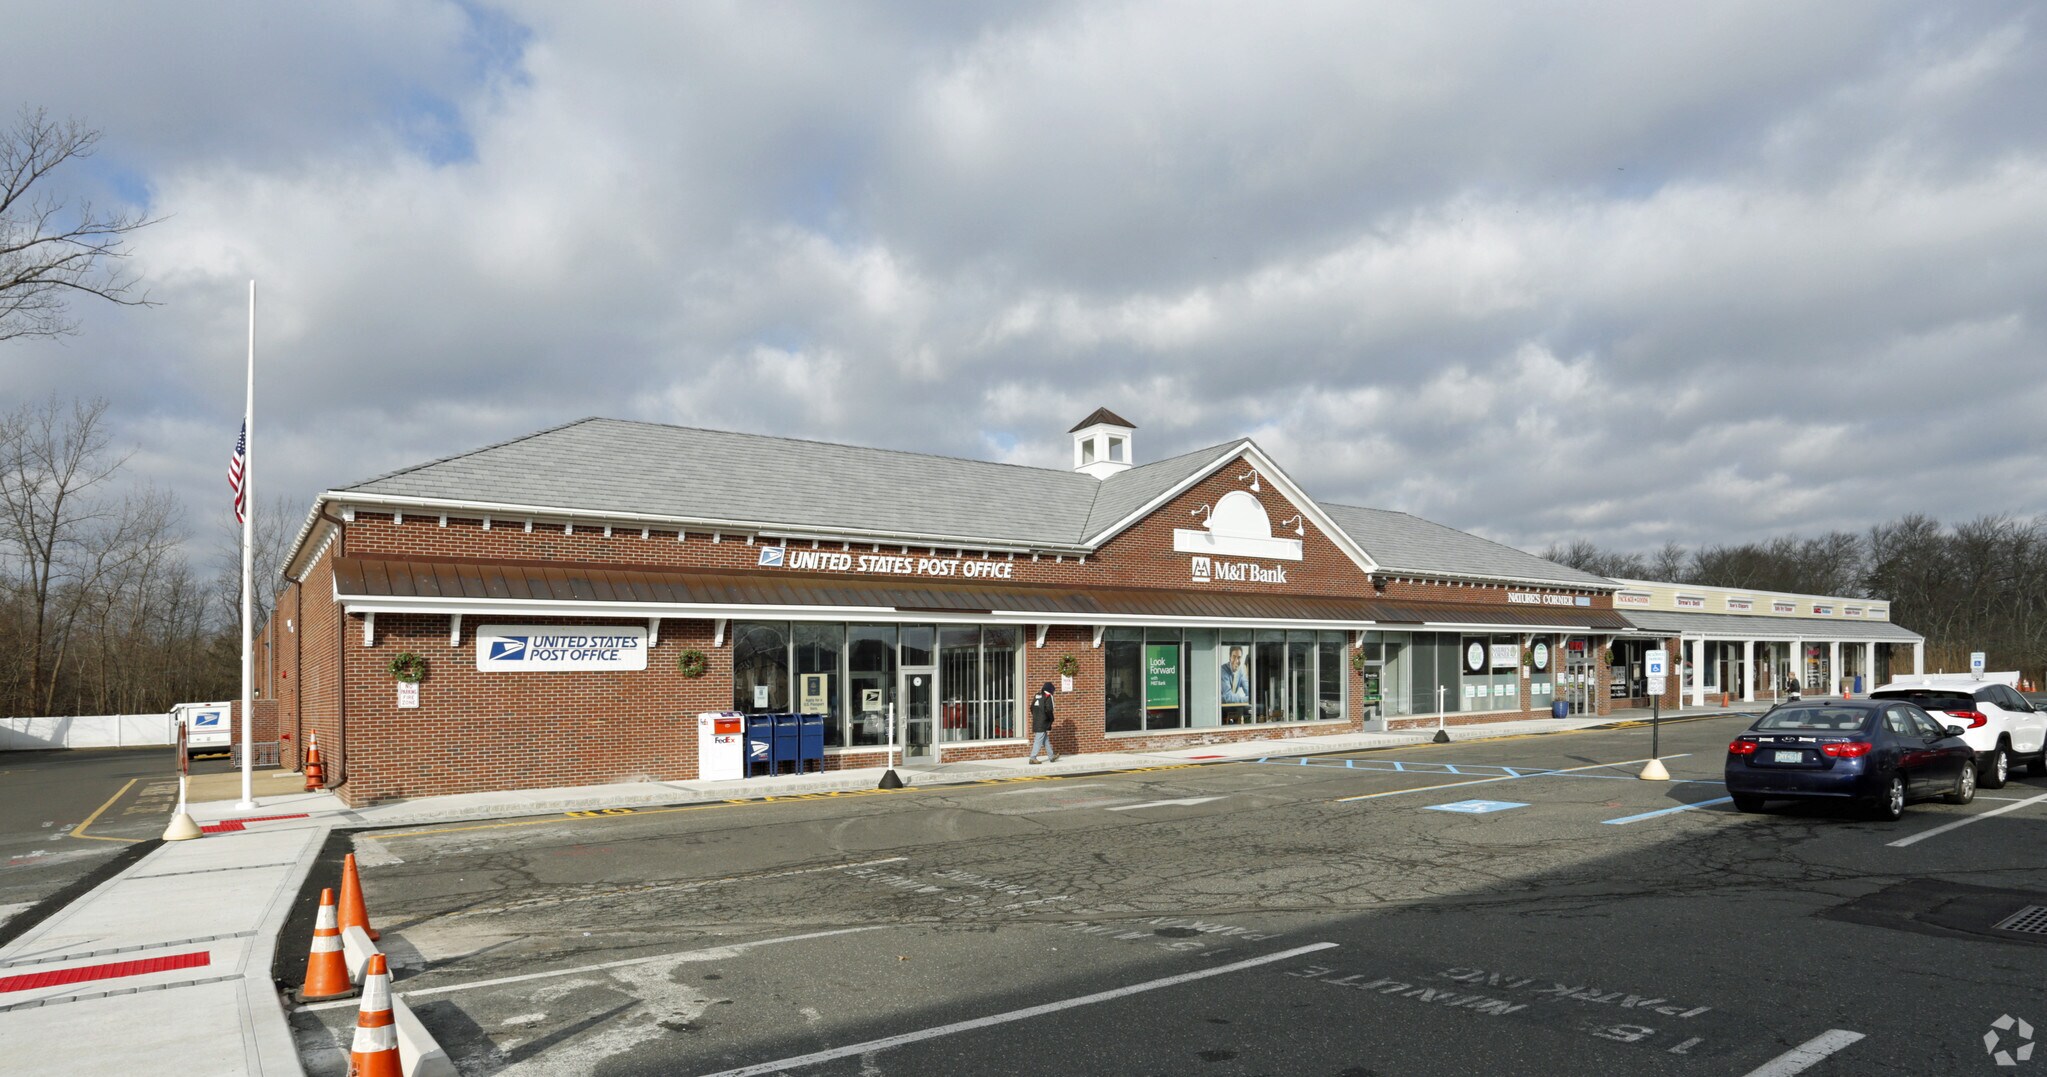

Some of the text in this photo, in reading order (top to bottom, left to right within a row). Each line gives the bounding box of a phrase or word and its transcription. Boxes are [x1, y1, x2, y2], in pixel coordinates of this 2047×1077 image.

[789, 551, 1013, 579] UNITED STATES POST OFFICE
[1214, 561, 1287, 583] M&T Bank
[1542, 594, 1574, 606] CORNER
[533, 636, 639, 648] UNITED STATES
[530, 649, 619, 661] POST OFFICE
[1150, 657, 1166, 666] Look
[1150, 665, 1176, 675] Forward
[714, 736, 736, 744] FedEx
[1437, 967, 1712, 1018] PARKING
[1283, 965, 1705, 1055] 15 MINUTE
